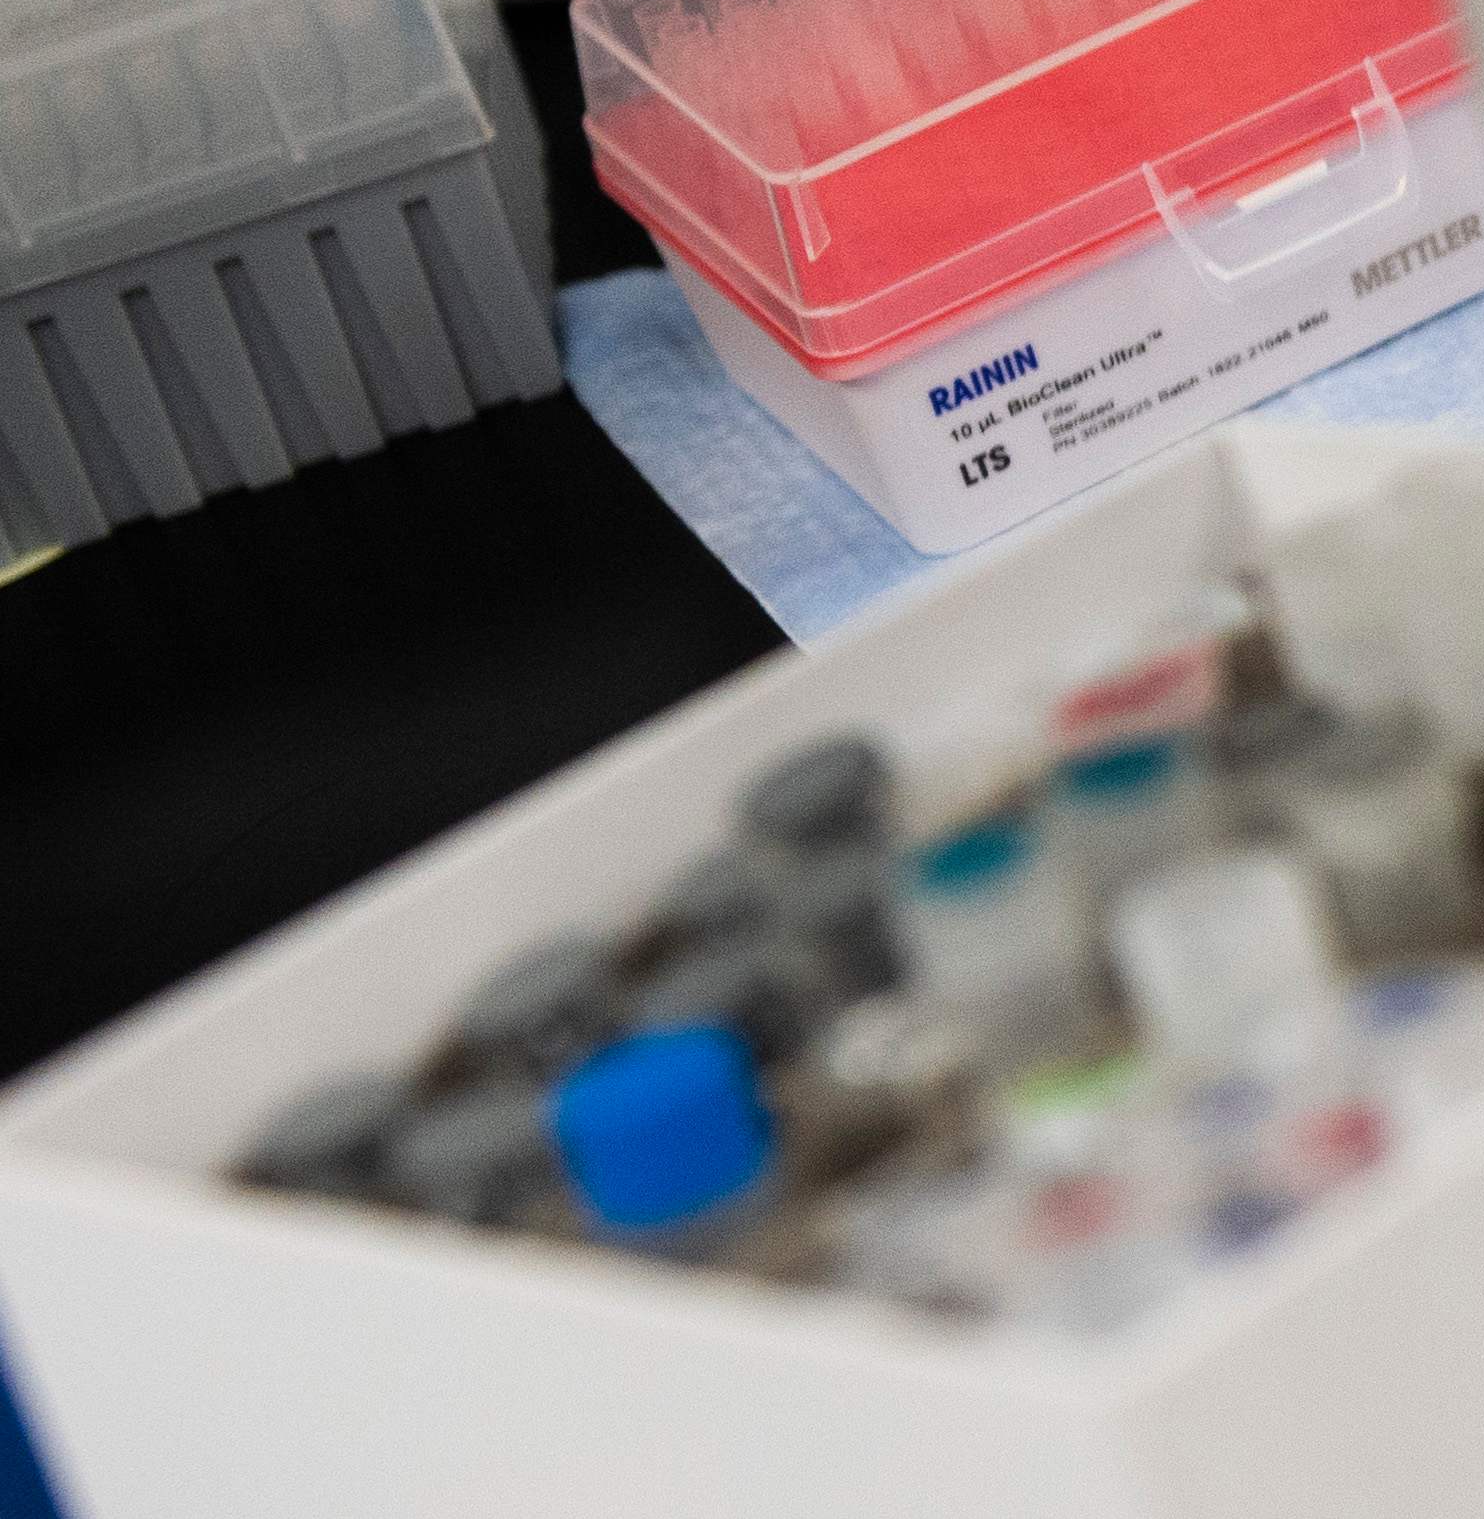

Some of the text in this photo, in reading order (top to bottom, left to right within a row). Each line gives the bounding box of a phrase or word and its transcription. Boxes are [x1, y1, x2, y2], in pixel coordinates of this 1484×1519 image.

[1349, 213, 1483, 297] METTLER
[928, 343, 1040, 417] RAININ
[951, 421, 973, 443] 10
[1007, 365, 1097, 417] BioClean
[1158, 375, 1200, 403] Batch
[959, 443, 1012, 489] LTS
